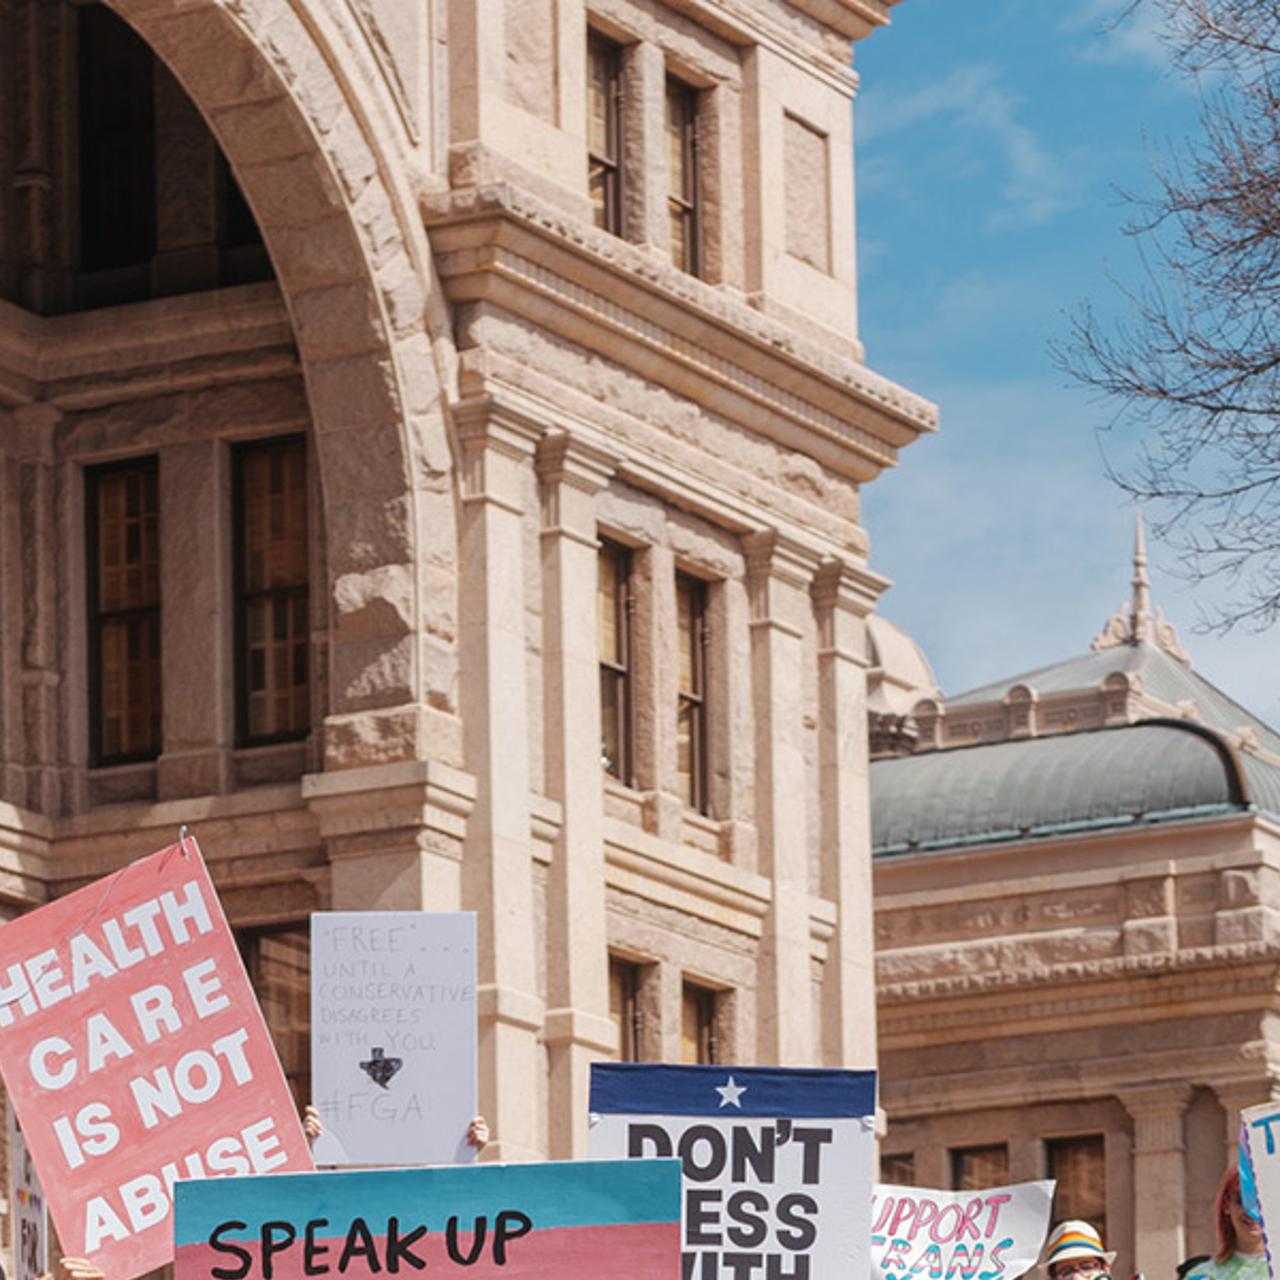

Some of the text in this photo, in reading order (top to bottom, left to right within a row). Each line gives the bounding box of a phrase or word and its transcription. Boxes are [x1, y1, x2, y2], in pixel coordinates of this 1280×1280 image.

[319, 983, 475, 1003] CONSERVATIVE
[322, 962, 416, 979] UNTIL A
[29, 958, 230, 1090] CARE
[319, 1030, 436, 1051] WITH YOU
[321, 1007, 421, 1025] DISAGREES
[53, 1028, 254, 1171] IS NOT
[320, 1090, 423, 1124] #FGA
[628, 1119, 833, 1185] DON'T
[84, 1118, 288, 1254] ABUSE
[208, 1211, 533, 1280] SPEAK UP
